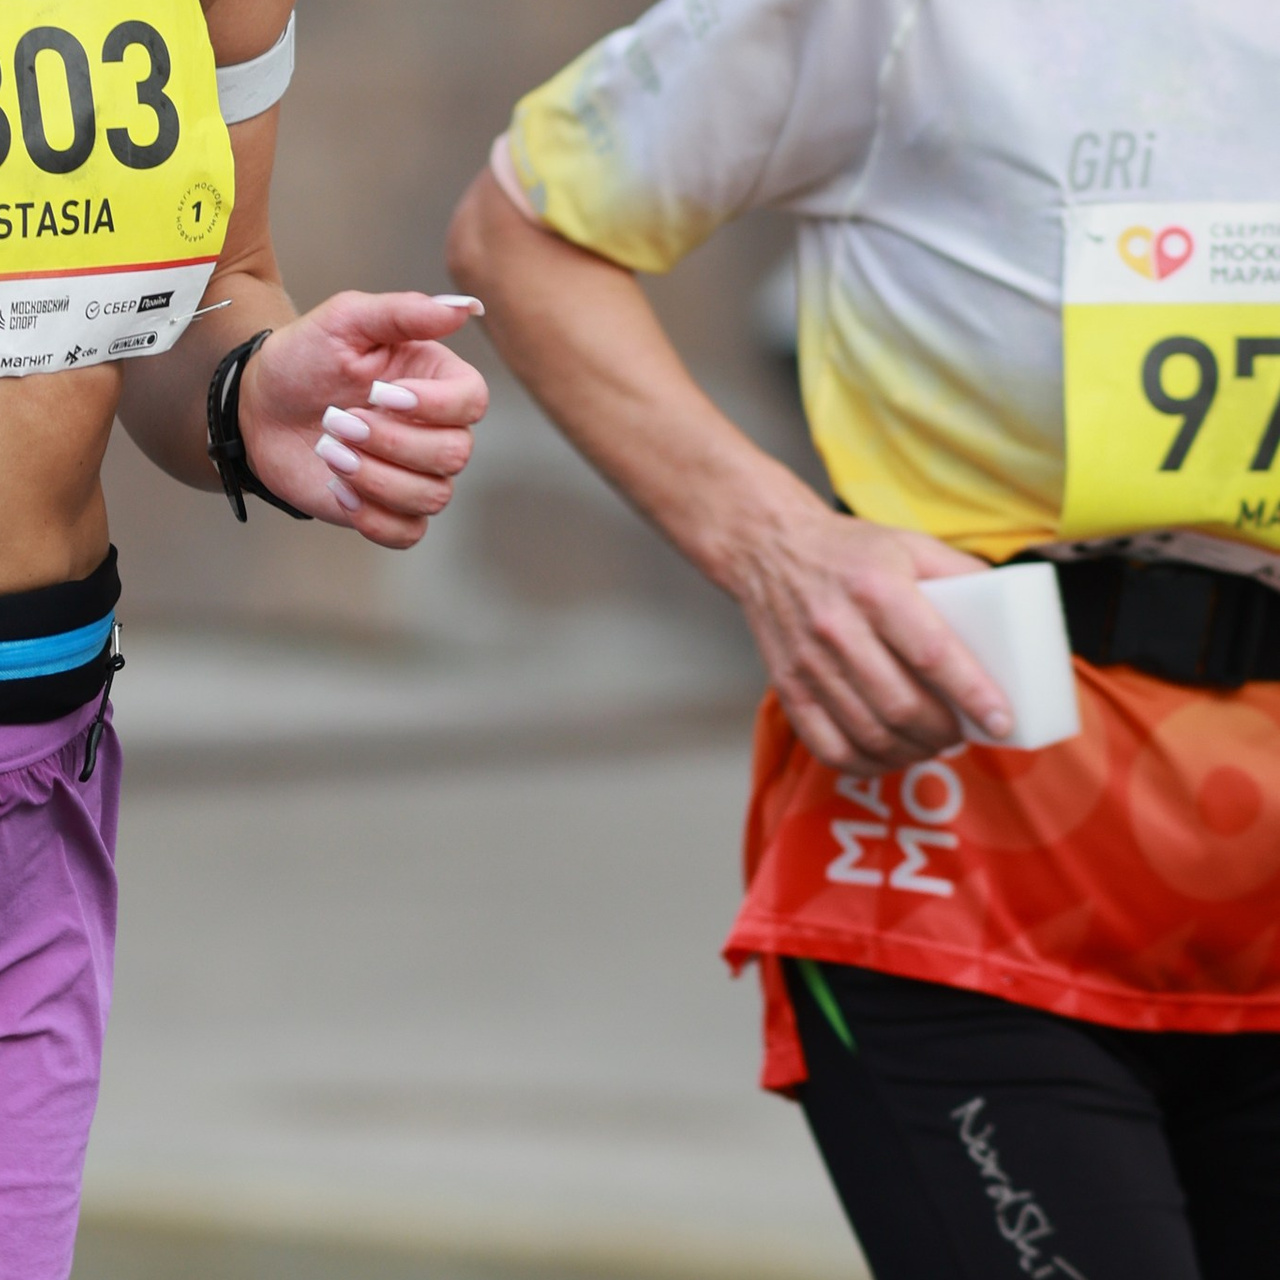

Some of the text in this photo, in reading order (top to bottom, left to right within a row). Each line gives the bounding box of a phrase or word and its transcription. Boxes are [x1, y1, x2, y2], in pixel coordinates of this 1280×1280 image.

[192, 200, 202, 223] 1
[1210, 266, 1280, 285] МАРА
[10, 295, 70, 315] МОСКОВСКИЙ
[103, 300, 137, 315] СБЕР
[9, 315, 39, 331] СПОРТ
[112, 337, 147, 351] WINLINE
[1141, 335, 1280, 473] 97
[889, 741, 967, 898] МО
